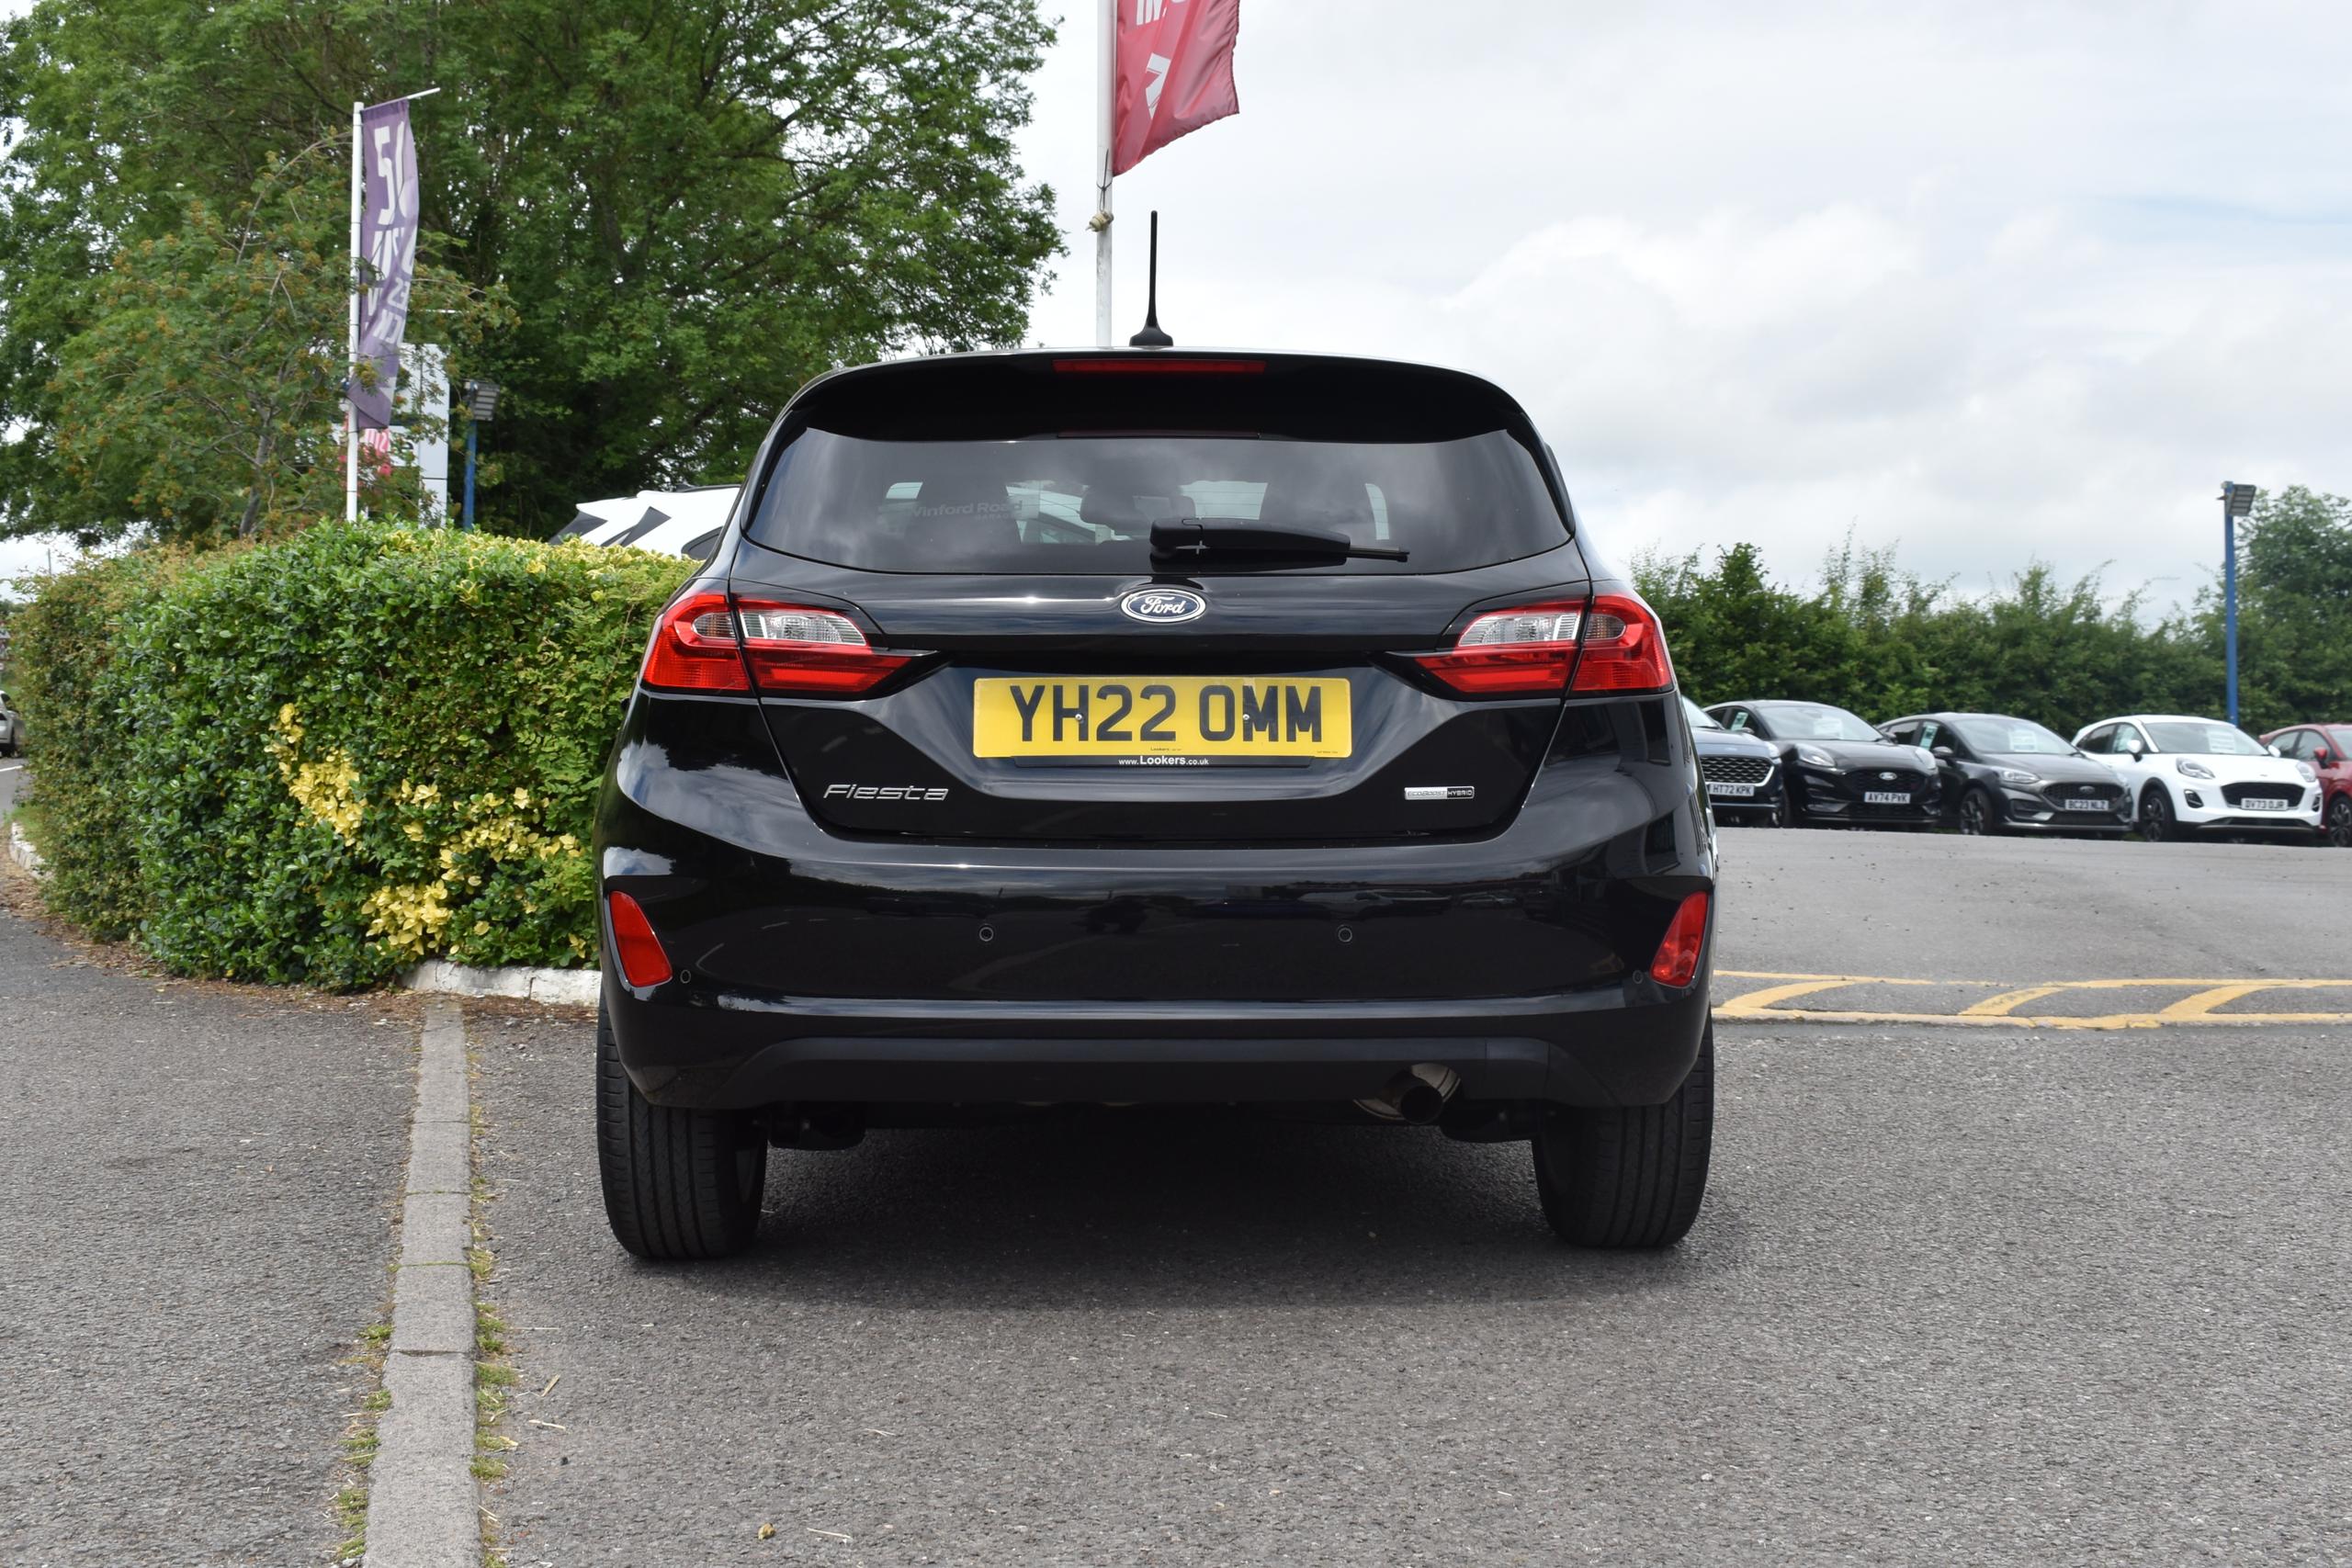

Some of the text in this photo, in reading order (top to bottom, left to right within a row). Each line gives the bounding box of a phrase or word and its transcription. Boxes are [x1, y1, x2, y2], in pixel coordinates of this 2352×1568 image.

[1140, 596, 1186, 614] Ford
[1010, 684, 1322, 742] YH22 OMM
[1118, 755, 1209, 765] www.Lookers.co.uk
[823, 784, 949, 801] Fiesta
